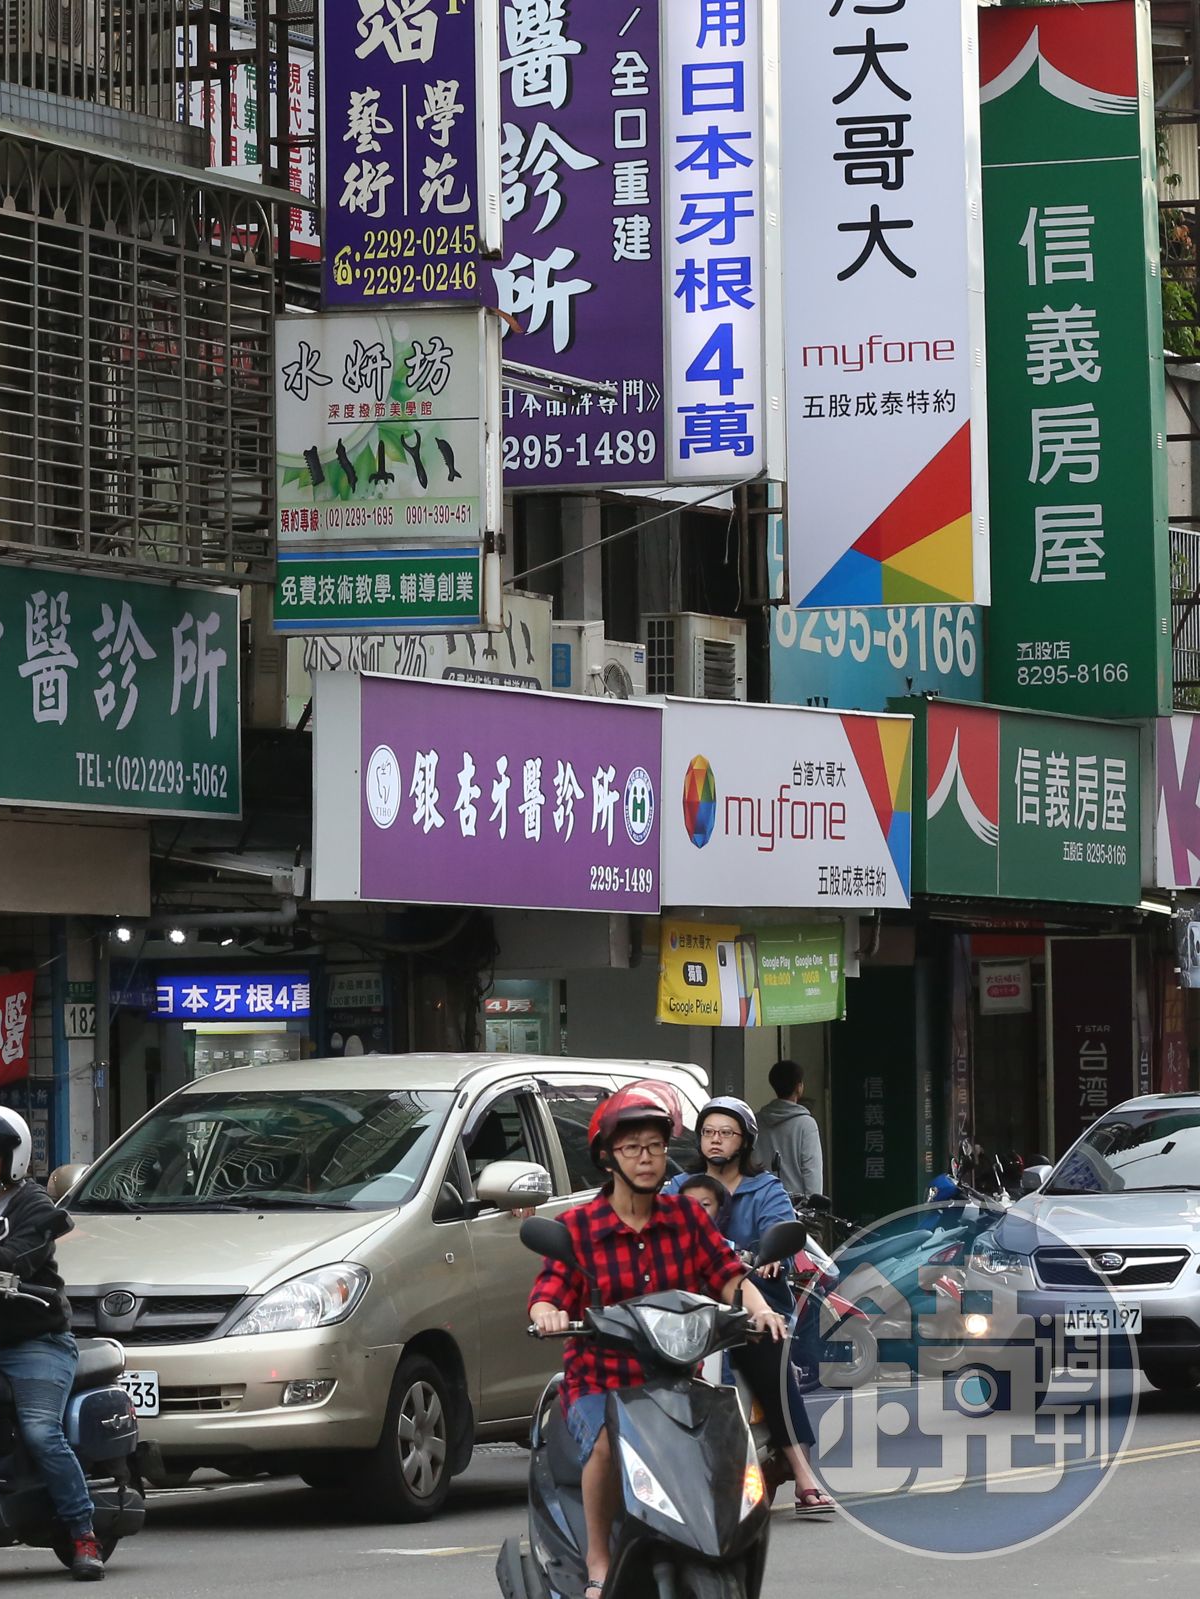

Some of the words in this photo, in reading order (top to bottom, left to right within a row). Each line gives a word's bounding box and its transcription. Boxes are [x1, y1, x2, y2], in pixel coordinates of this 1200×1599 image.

[829, 0, 917, 282] 大哥大
[363, 224, 476, 260] 2292-0245
[363, 261, 477, 296] 2292-0246
[282, 336, 453, 401] 水妍坊
[802, 335, 955, 372] myfone
[328, 401, 432, 419] 深度撥筋美學館
[802, 389, 956, 420] 五股成泰特約
[1019, 204, 1106, 584] 信義房屋
[406, 505, 471, 525] 0901-390-451
[1017, 641, 1071, 661] 五股店
[1017, 663, 1129, 686] 8295-8166
[409, 749, 620, 847] 銀杏牙醫診所
[1015, 746, 1127, 833] 信義房屋
[724, 784, 846, 852] myfone
[1063, 841, 1083, 862] 五股店
[1086, 842, 1127, 866] 8295-8166
[590, 865, 653, 894] 2295-1489
[817, 865, 887, 897] 五股成泰特約
[155, 982, 310, 1014] 日本牙根4萬
[670, 997, 694, 1016] Google
[696, 999, 712, 1014] Pixel
[713, 1001, 718, 1014] 4
[70, 1007, 97, 1034] 182
[1085, 1025, 1111, 1033] STAR
[864, 1077, 886, 1179] 信義房屋
[1067, 1308, 1140, 1330] AFK-3197
